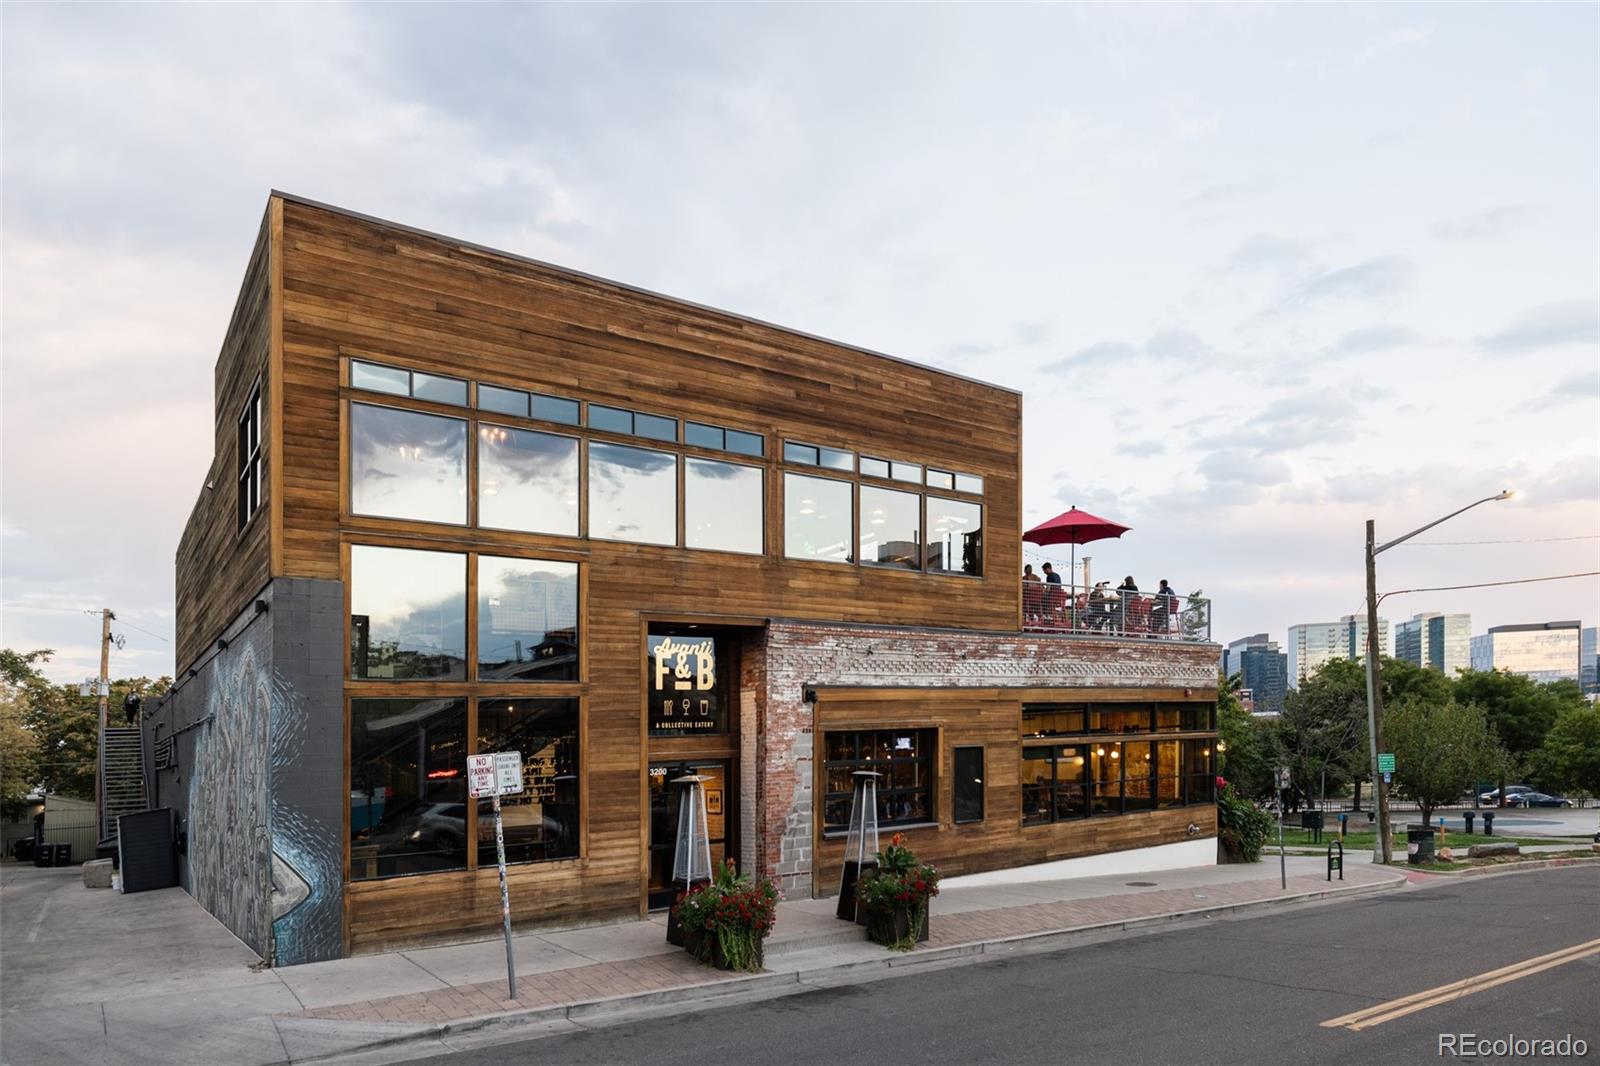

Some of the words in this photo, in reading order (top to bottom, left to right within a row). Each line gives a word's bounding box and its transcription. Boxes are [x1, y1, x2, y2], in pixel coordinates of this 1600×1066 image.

[654, 637, 713, 657] Avanti
[476, 758, 487, 766] NO
[470, 766, 493, 776] PARKING
[649, 768, 667, 776] 3200
